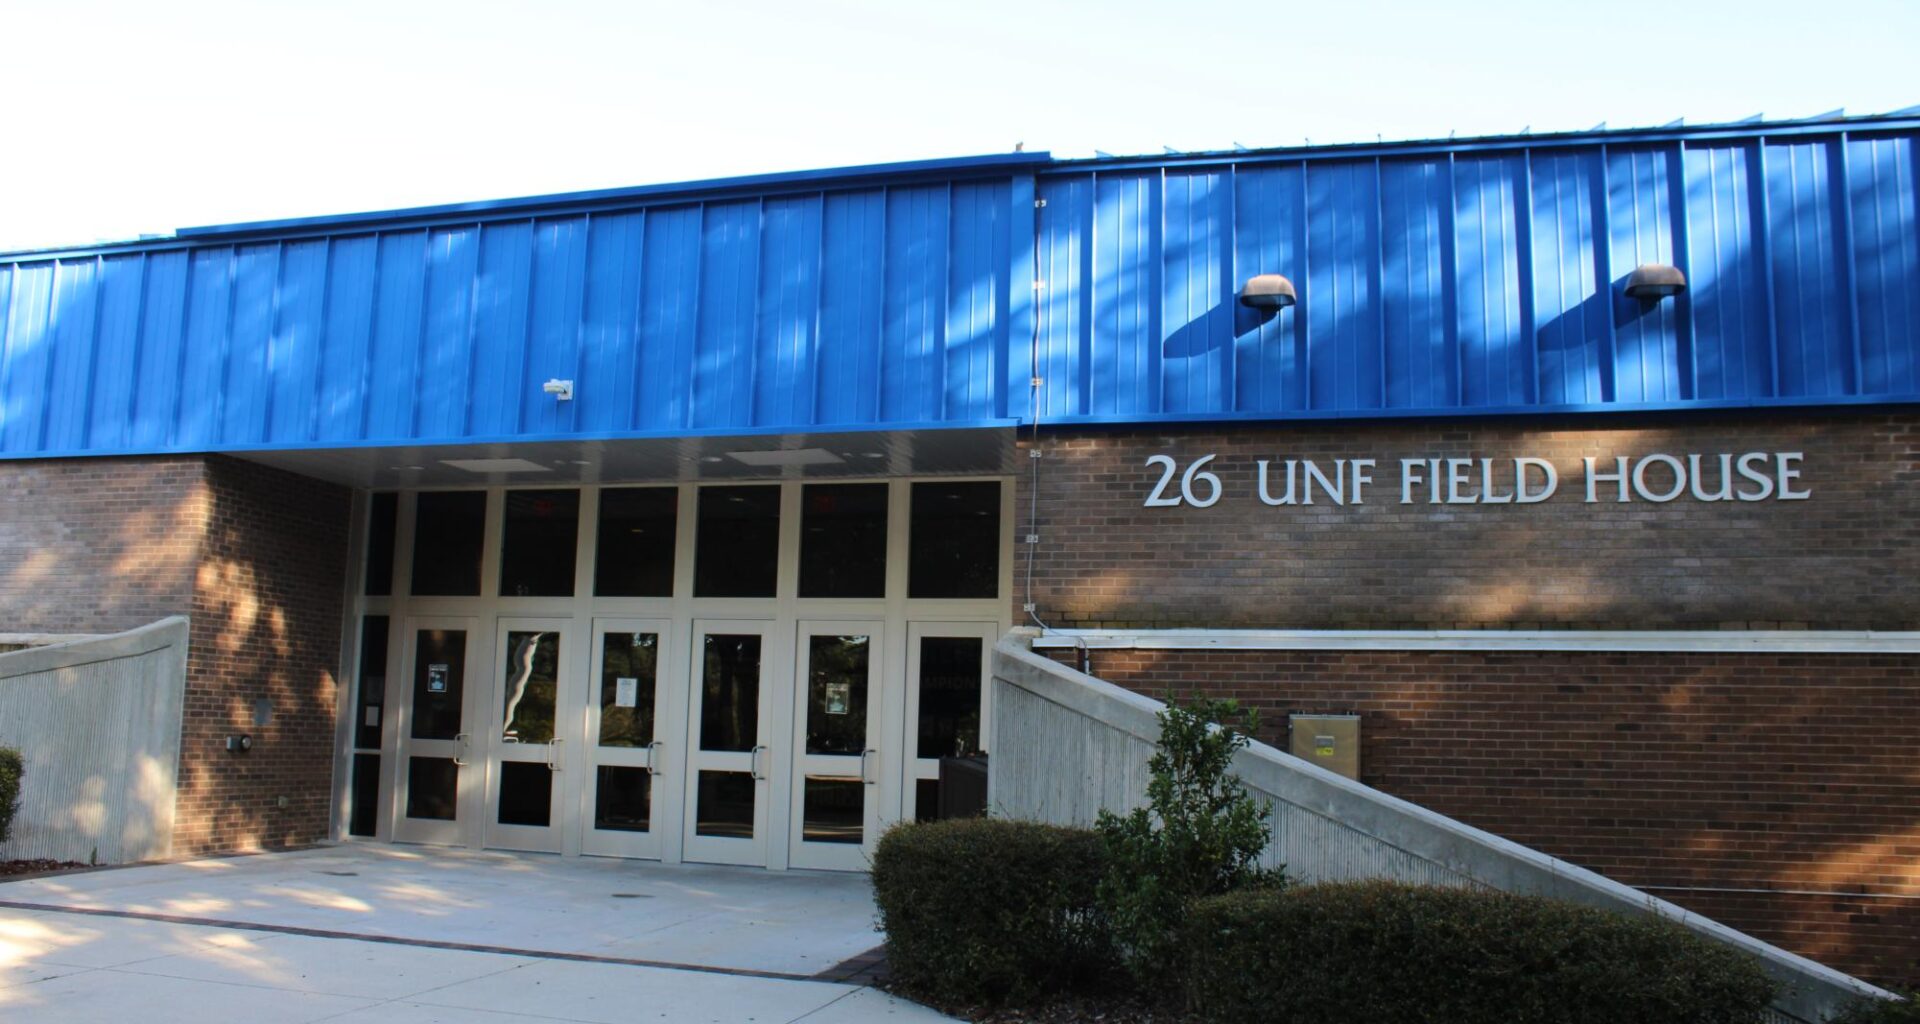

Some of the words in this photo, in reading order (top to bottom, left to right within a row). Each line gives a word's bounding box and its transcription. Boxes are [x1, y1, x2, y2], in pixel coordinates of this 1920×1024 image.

[1143, 453, 1222, 508] 26
[1257, 459, 1376, 506] UNF
[1400, 457, 1558, 504] FIELD
[1583, 452, 1811, 503] HOUSE
